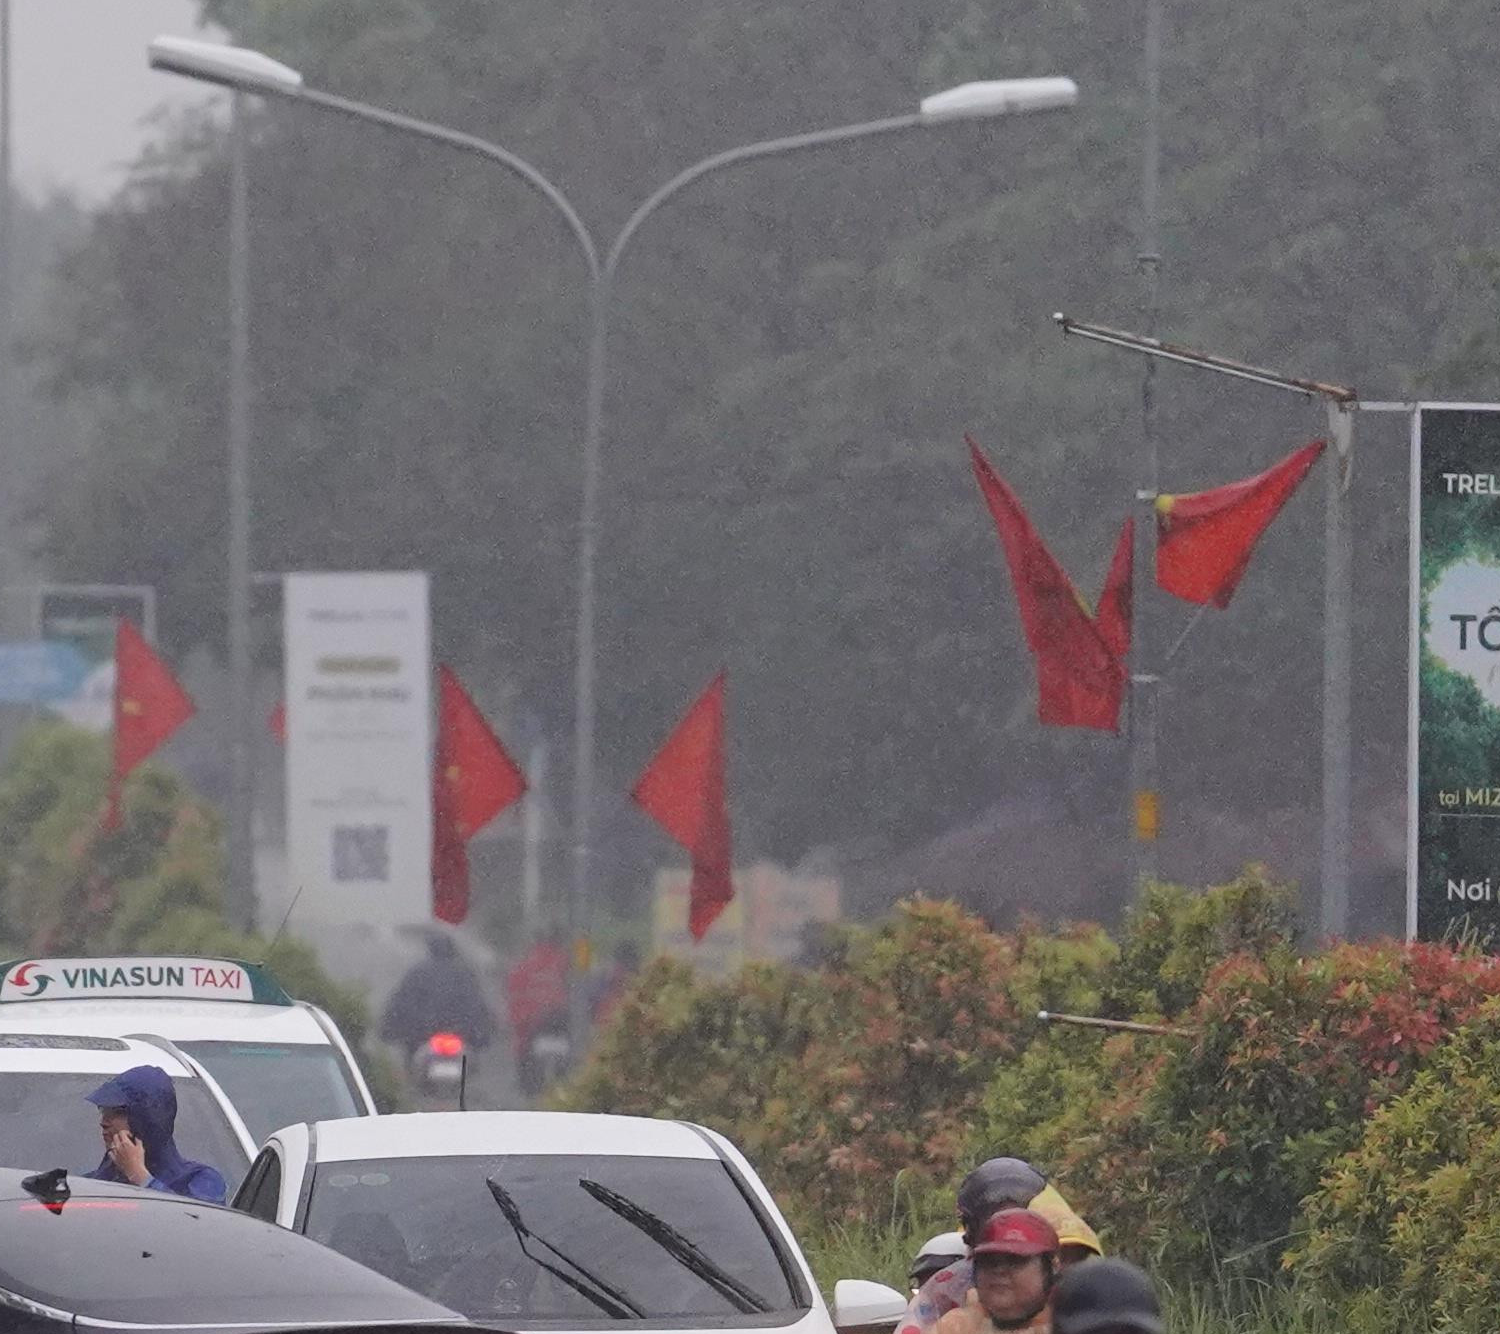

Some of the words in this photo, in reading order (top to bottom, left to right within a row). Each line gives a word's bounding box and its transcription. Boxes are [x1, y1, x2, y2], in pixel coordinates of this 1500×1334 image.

[1438, 789, 1461, 809] tại
[1447, 878, 1491, 901] Nơi
[62, 966, 184, 989] VINASUN
[190, 967, 242, 989] TAXI
